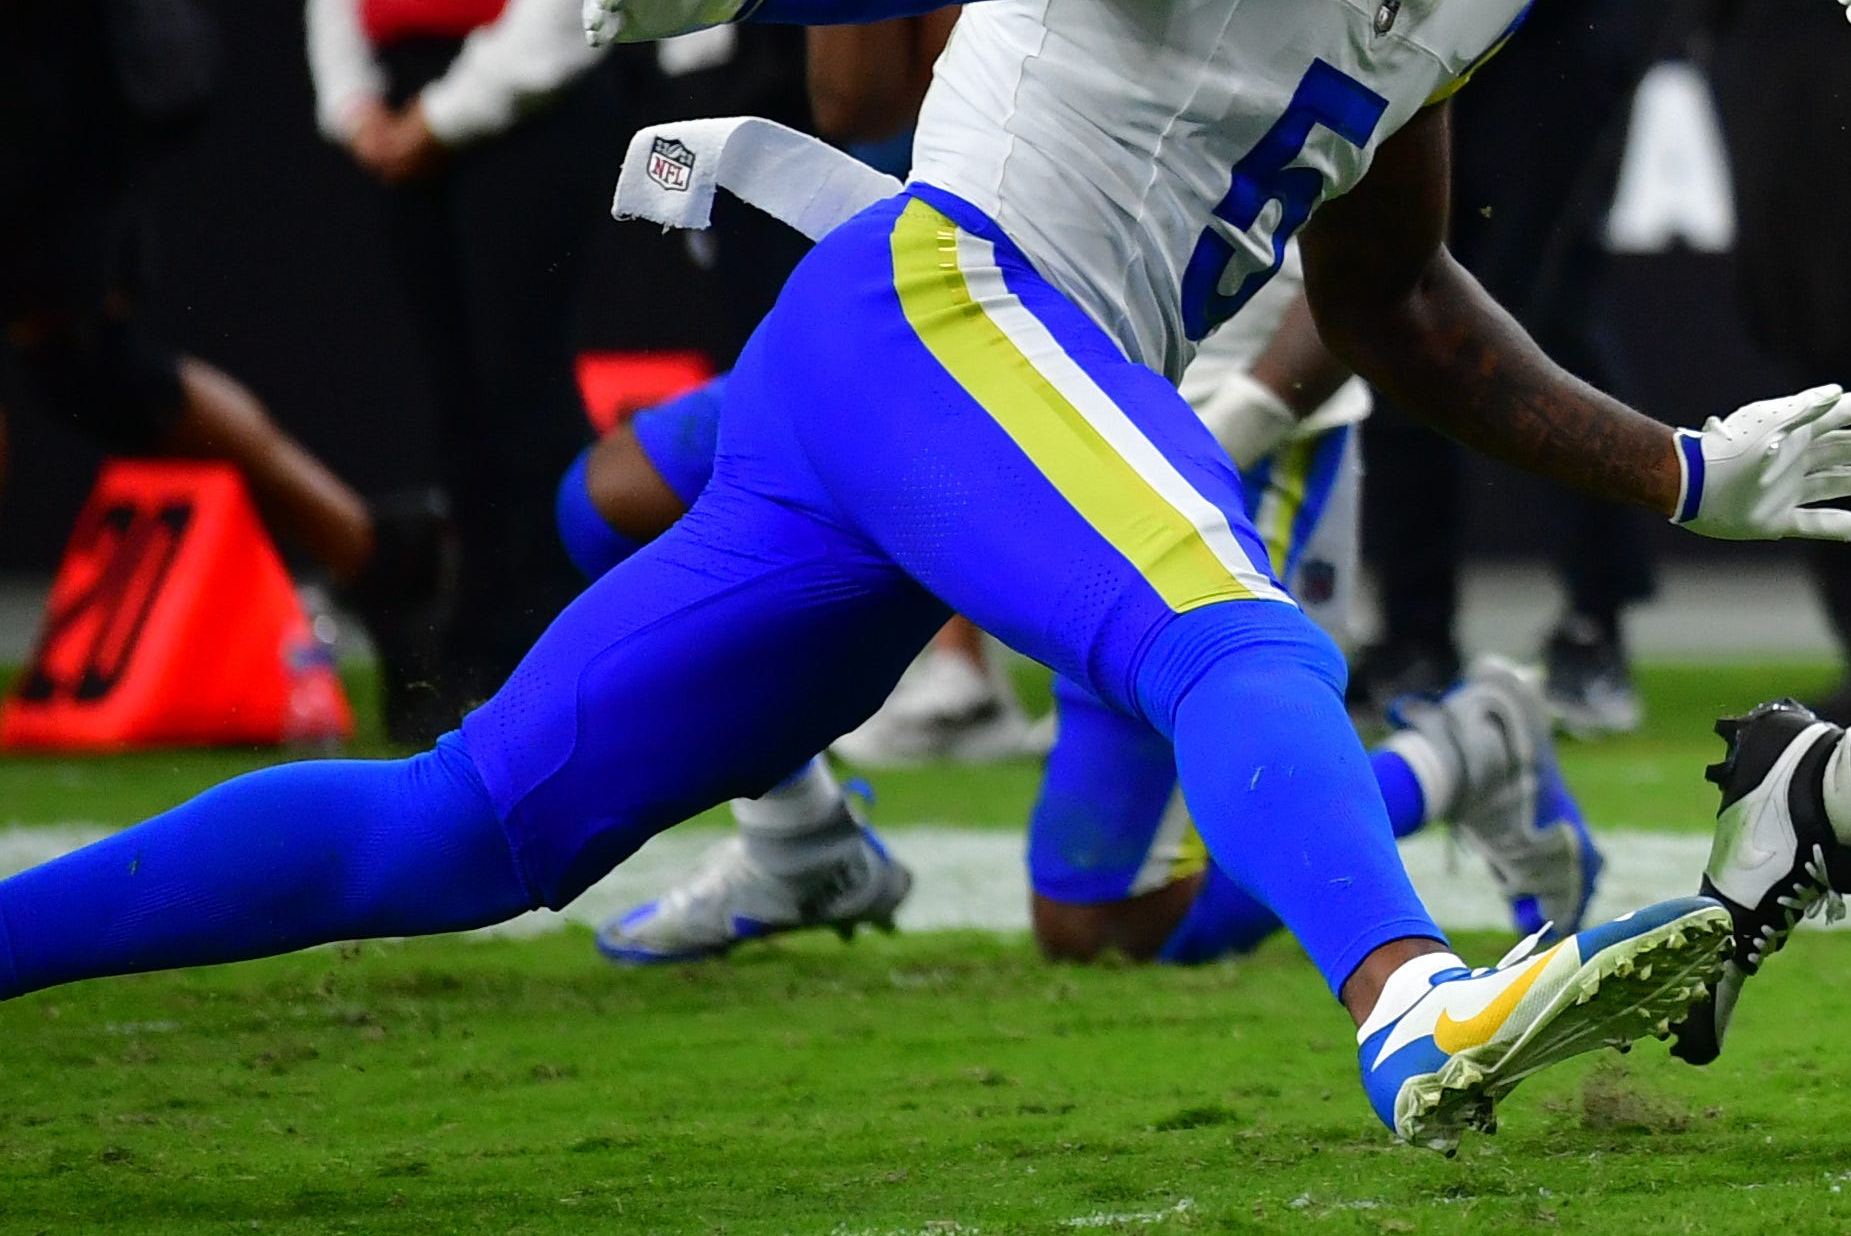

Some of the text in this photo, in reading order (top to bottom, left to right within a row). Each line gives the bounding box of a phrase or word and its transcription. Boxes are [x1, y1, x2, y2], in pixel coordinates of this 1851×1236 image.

[651, 155, 685, 187] NFL
[1181, 56, 1389, 342] 5
[1605, 61, 1738, 253] A
[22, 502, 196, 701] 20
